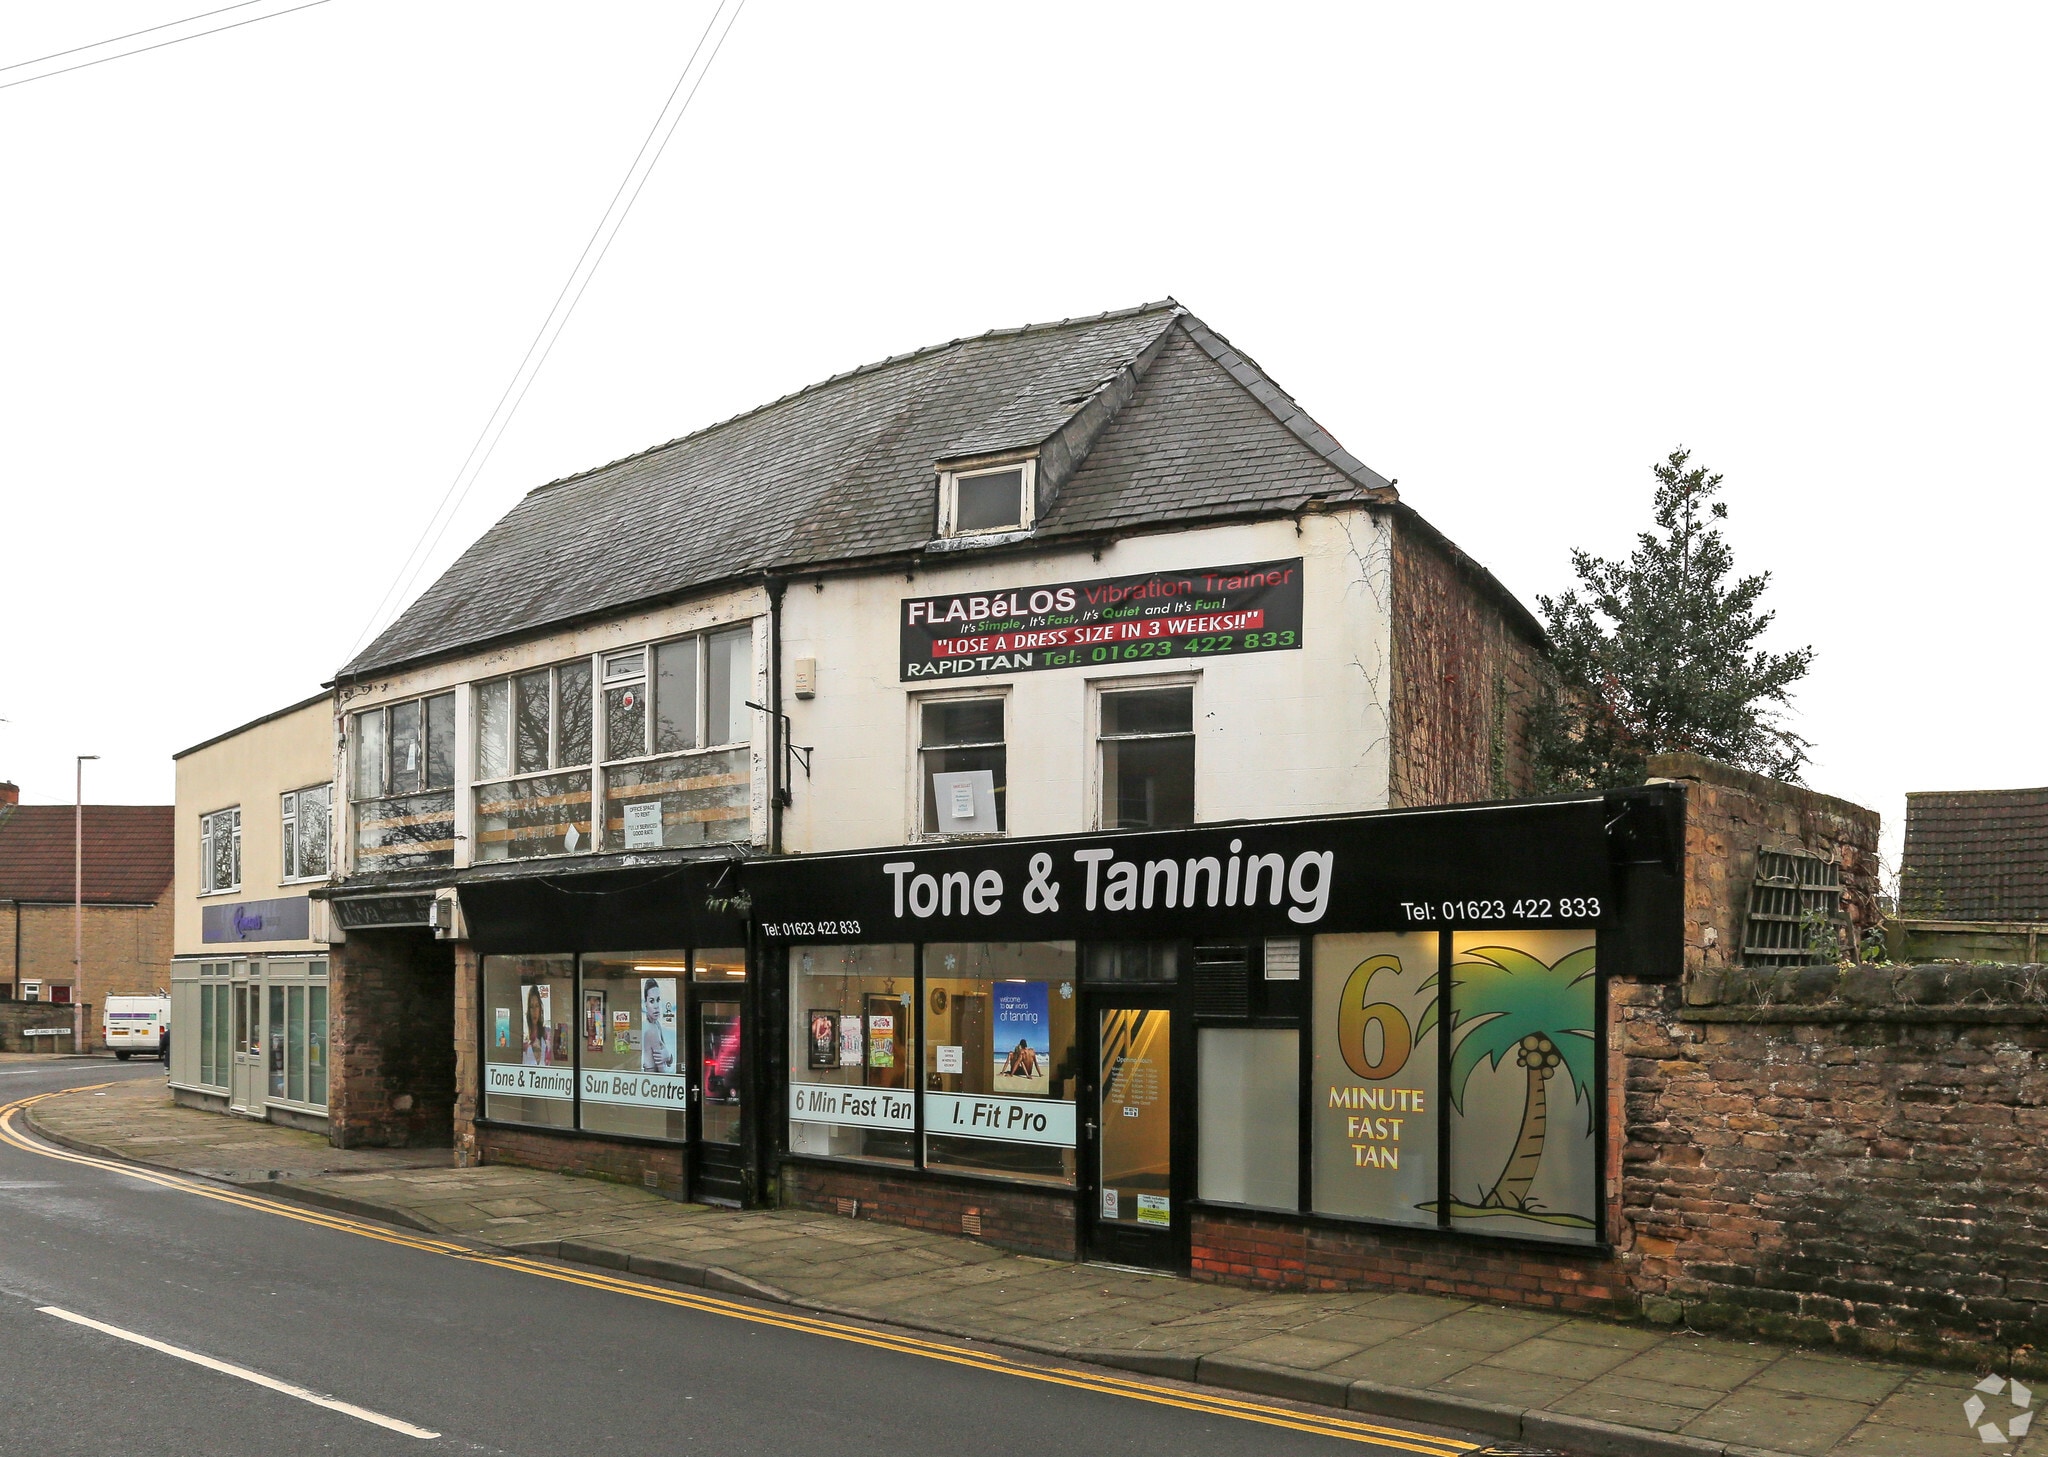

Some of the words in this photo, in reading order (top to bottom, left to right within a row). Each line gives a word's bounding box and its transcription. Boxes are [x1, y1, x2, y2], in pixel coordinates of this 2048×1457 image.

[908, 588, 1076, 626] FLABéLOS
[1083, 578, 1192, 605] Vibration
[1200, 569, 1294, 592] Trainer
[960, 623, 976, 634] It's
[1029, 616, 1046, 627] It's
[1083, 609, 1099, 621] It's
[1102, 606, 1140, 619] Quiet
[1145, 603, 1170, 615] and
[1174, 601, 1192, 612] It's
[1195, 597, 1226, 611] Fun!
[995, 636, 1007, 650] A
[1014, 630, 1068, 649] DRESS
[1074, 625, 1114, 643] SIZE
[1121, 622, 1140, 638] IN
[1148, 621, 1160, 636] 3
[907, 652, 1033, 676] RAPIDTAN
[1042, 649, 1082, 666] Tel:
[1092, 641, 1172, 661] 01623
[1184, 635, 1234, 652] 422
[1244, 630, 1295, 648] 833
[883, 861, 1003, 918] Tone
[1022, 852, 1060, 914] &
[1073, 838, 1334, 924] Tanning
[1401, 902, 1436, 920] Tel:
[1442, 900, 1506, 919] 01623
[1512, 899, 1553, 918] 422
[1559, 897, 1601, 917] 833
[762, 923, 781, 936] Tel:
[782, 922, 815, 936] 01623
[817, 921, 838, 935] 422
[839, 920, 860, 934] 833
[1000, 1010, 1008, 1021] of
[1009, 1011, 1038, 1024] tanning
[1338, 954, 1412, 1081] 6
[490, 1069, 514, 1086] Tone
[517, 1070, 525, 1087] &
[529, 1071, 572, 1096] Tanning
[586, 1074, 608, 1094] Sun
[612, 1076, 637, 1096] Bed
[641, 1078, 685, 1100] Centre
[796, 1090, 805, 1110] 6
[809, 1091, 836, 1114] Min
[841, 1093, 876, 1117] Fast
[882, 1096, 912, 1120] Tan
[1328, 1087, 1424, 1113] MINUTE
[972, 1102, 1001, 1128] Fit
[1007, 1105, 1047, 1132] Pro
[1348, 1117, 1404, 1141] FAST
[1352, 1144, 1399, 1170] TAN
